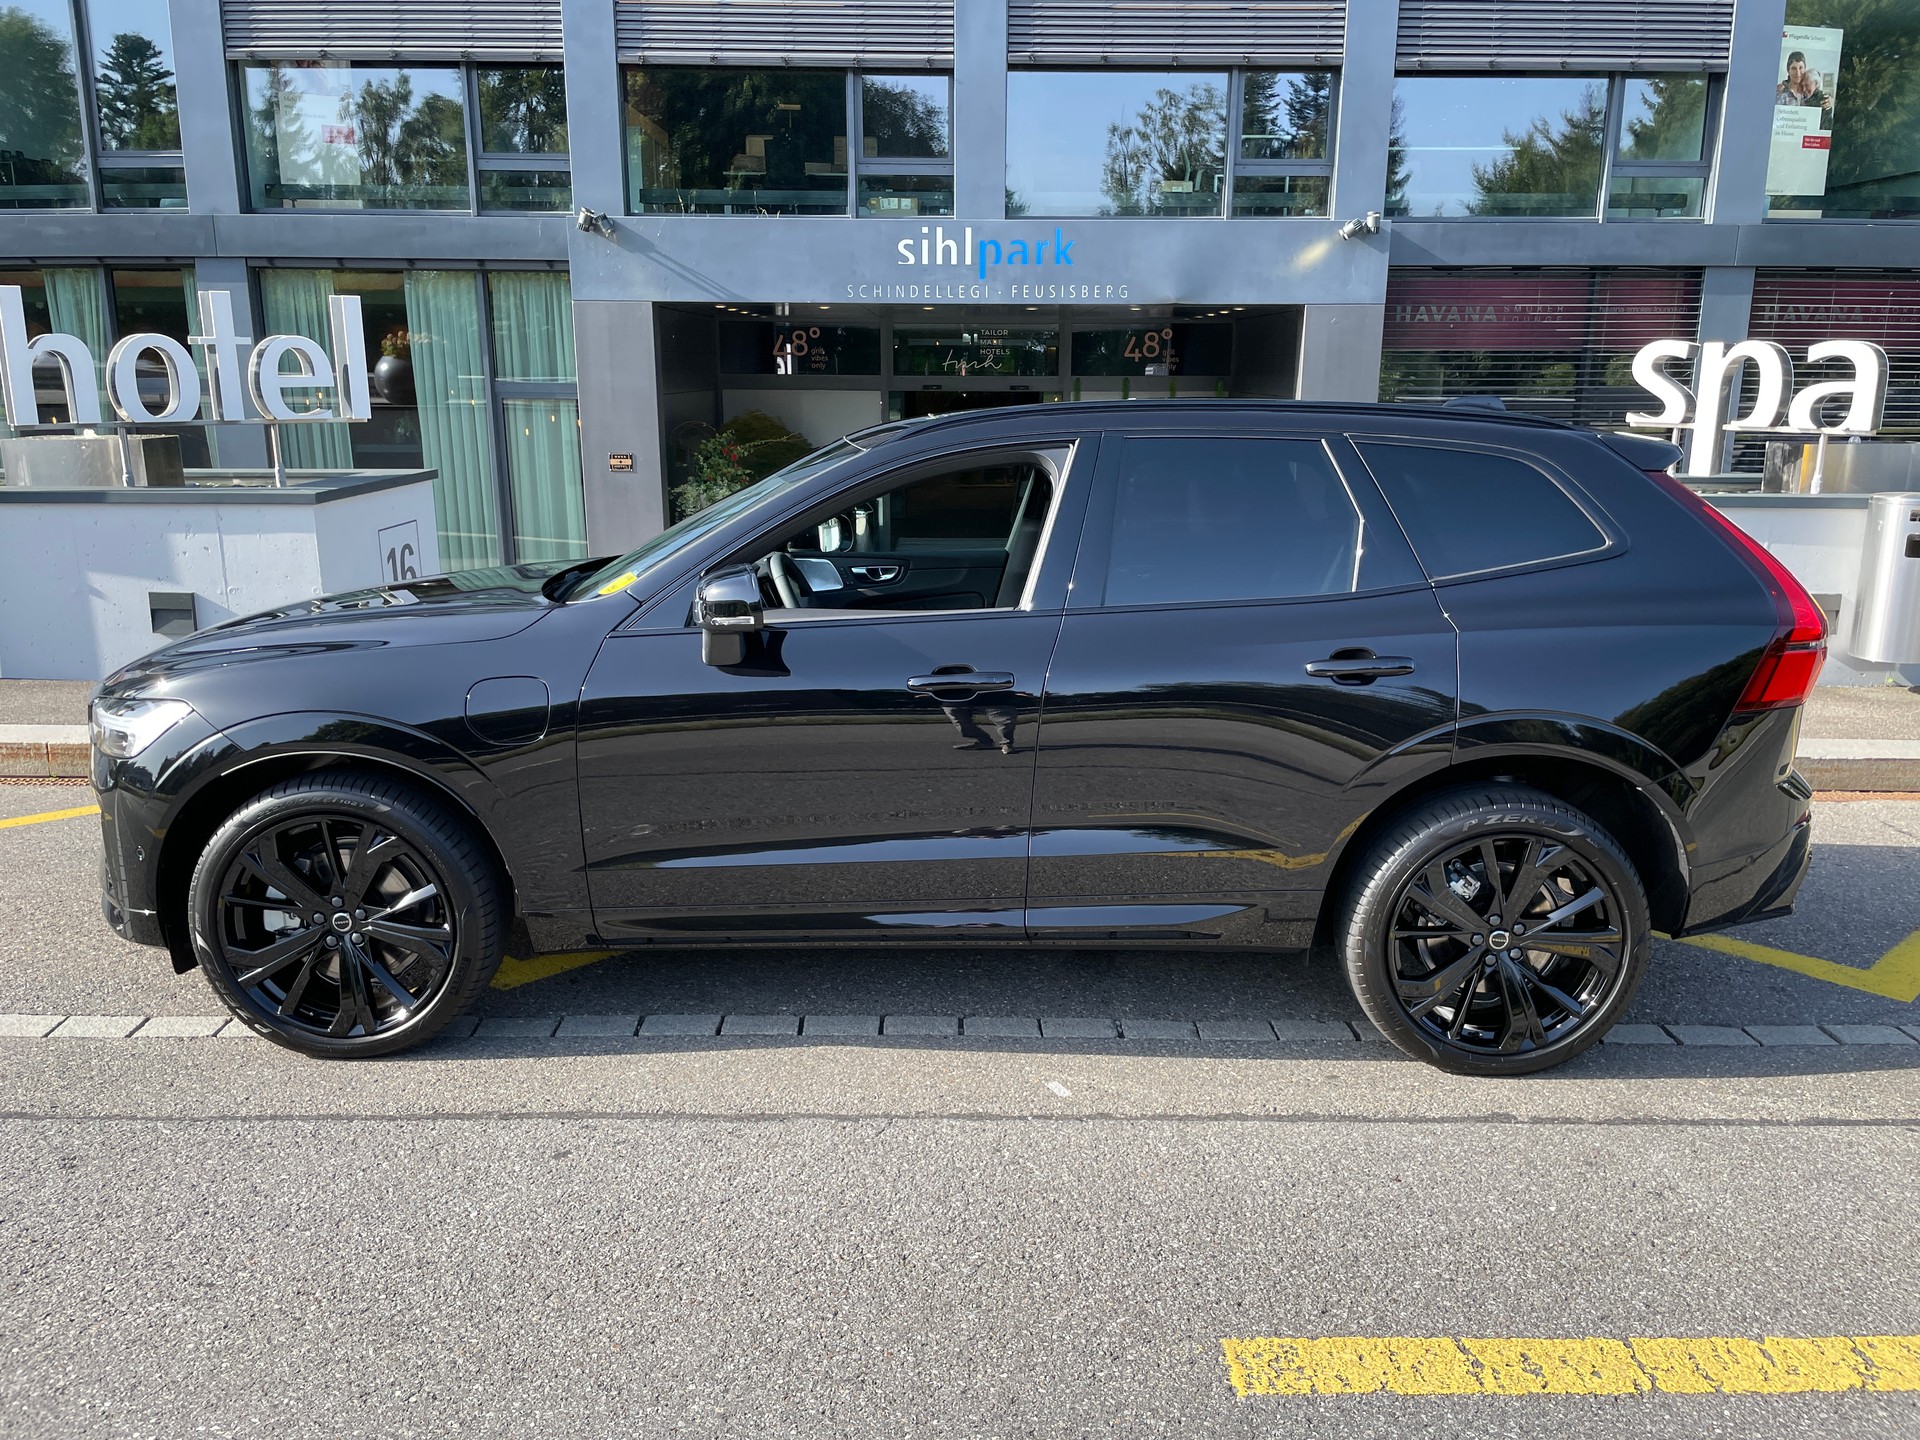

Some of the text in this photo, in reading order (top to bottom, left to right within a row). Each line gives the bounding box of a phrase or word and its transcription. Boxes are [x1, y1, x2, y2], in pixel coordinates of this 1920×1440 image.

[897, 226, 1076, 281] sihlpark
[847, 284, 1128, 299] SCHINDELLEGI FEUSISBERG
[1395, 304, 1498, 322] HAVANA
[1763, 305, 1864, 322] HAVANA
[0, 284, 372, 426] hotel
[1625, 339, 1890, 477] spa
[387, 543, 418, 582] 16
